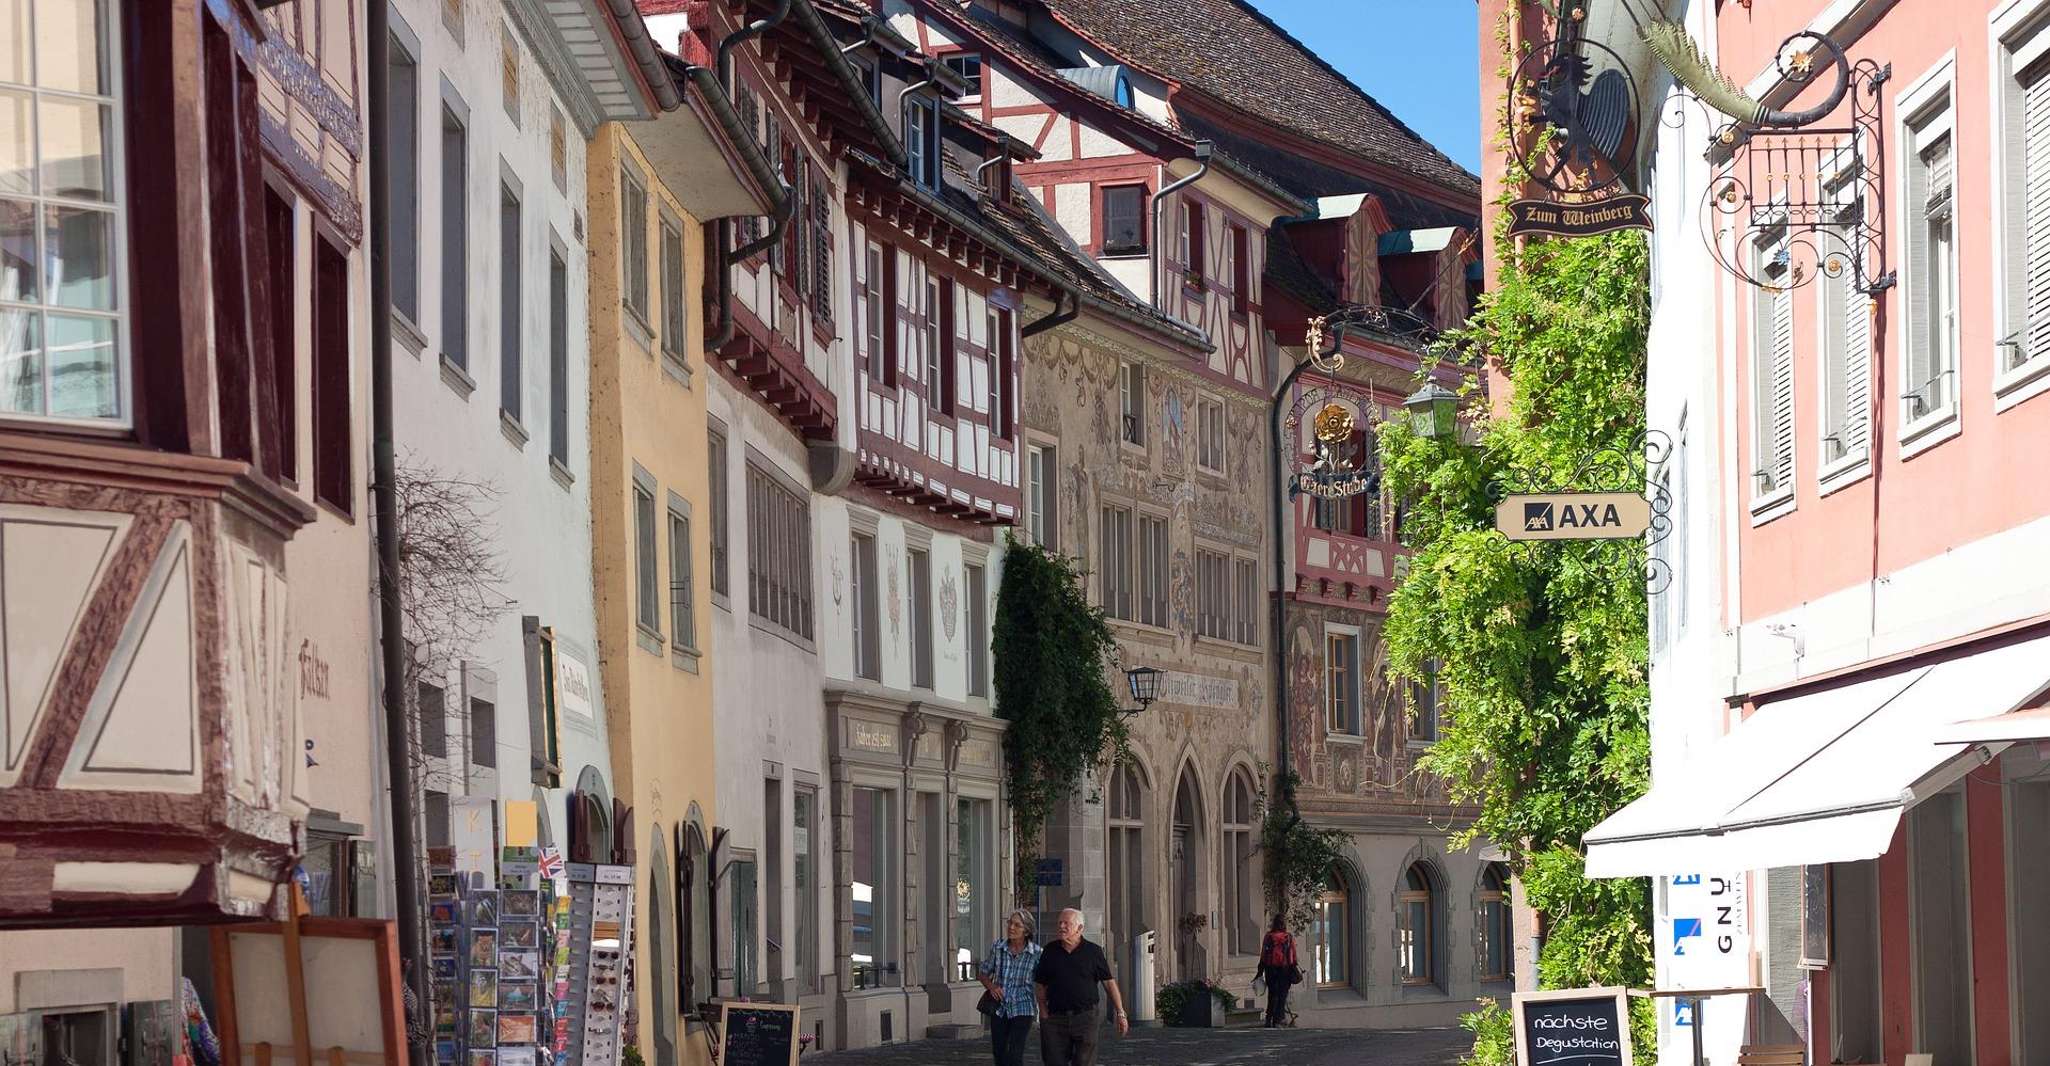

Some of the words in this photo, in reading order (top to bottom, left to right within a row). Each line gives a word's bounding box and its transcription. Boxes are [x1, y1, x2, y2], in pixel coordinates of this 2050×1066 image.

[1526, 206, 1557, 224] Zum
[1562, 205, 1633, 226] Weinberg
[1558, 503, 1622, 528] AXA
[1535, 1014, 1608, 1031] nächste
[1536, 1036, 1619, 1053] Degustation
